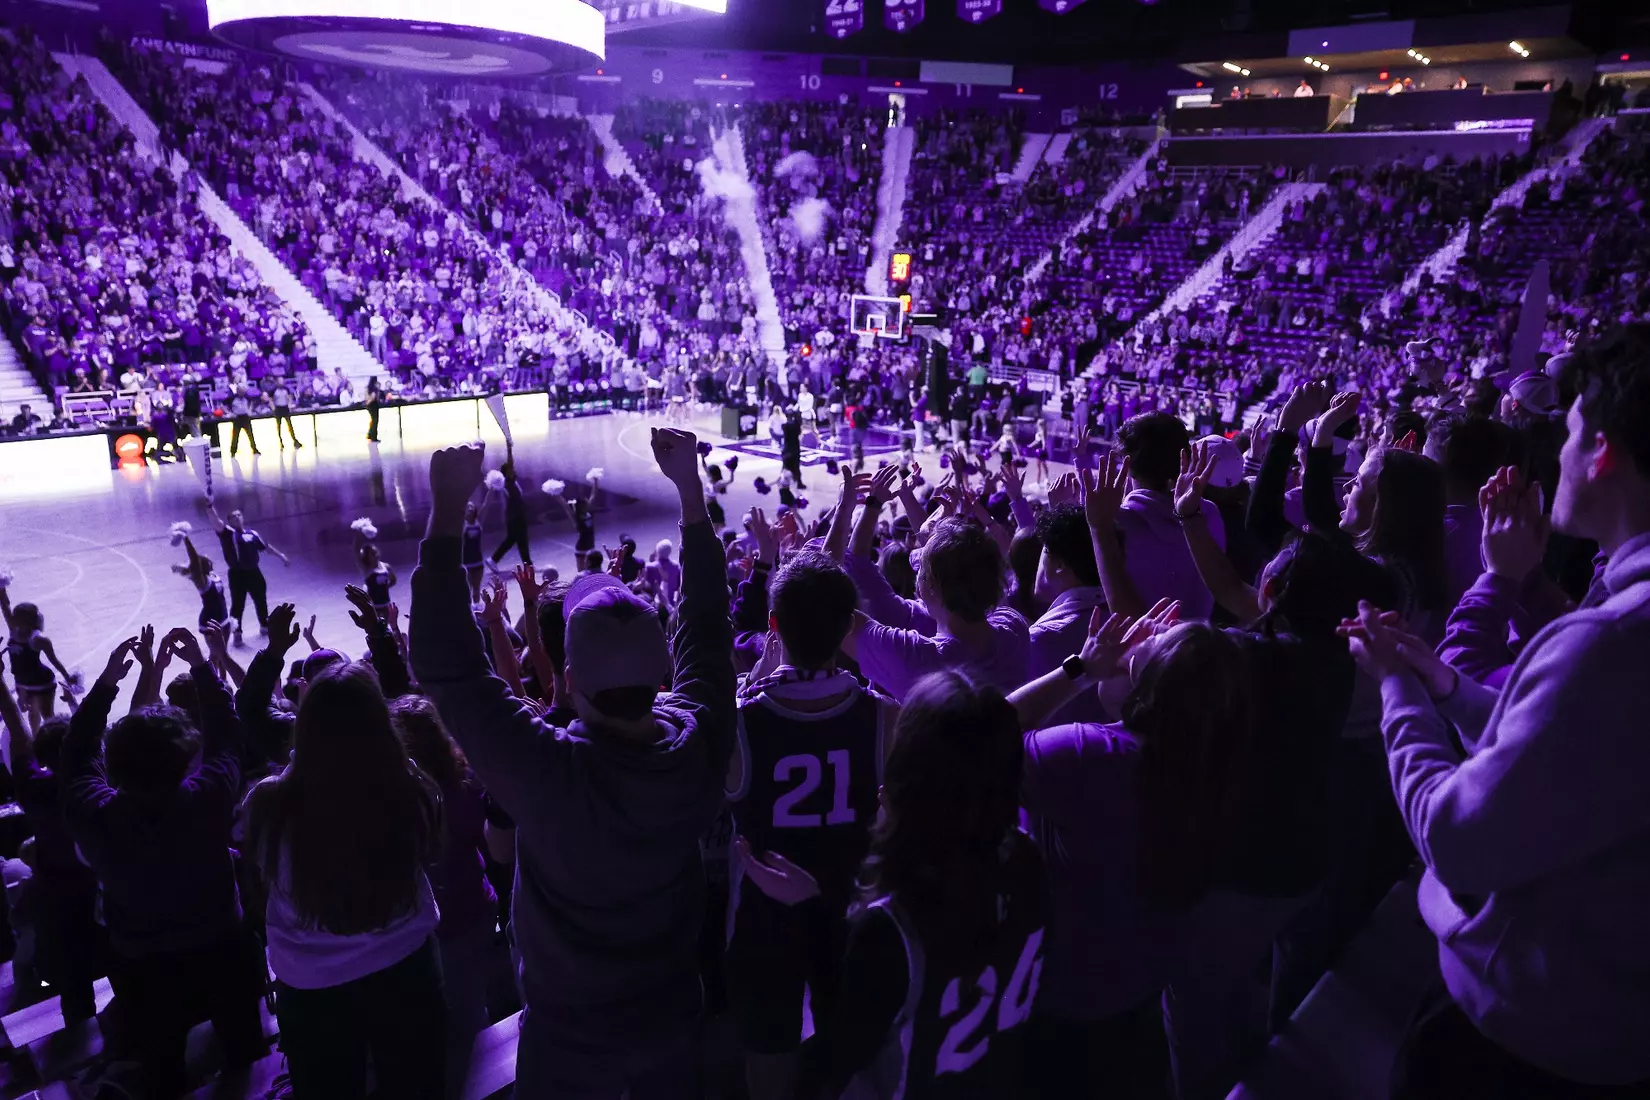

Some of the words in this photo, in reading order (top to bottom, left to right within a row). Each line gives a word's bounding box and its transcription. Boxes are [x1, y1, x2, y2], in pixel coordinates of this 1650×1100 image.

[651, 68, 663, 84] 9
[800, 74, 820, 89] 10
[956, 82, 971, 97] 11
[1100, 83, 1118, 99] 12
[772, 749, 856, 828] 21
